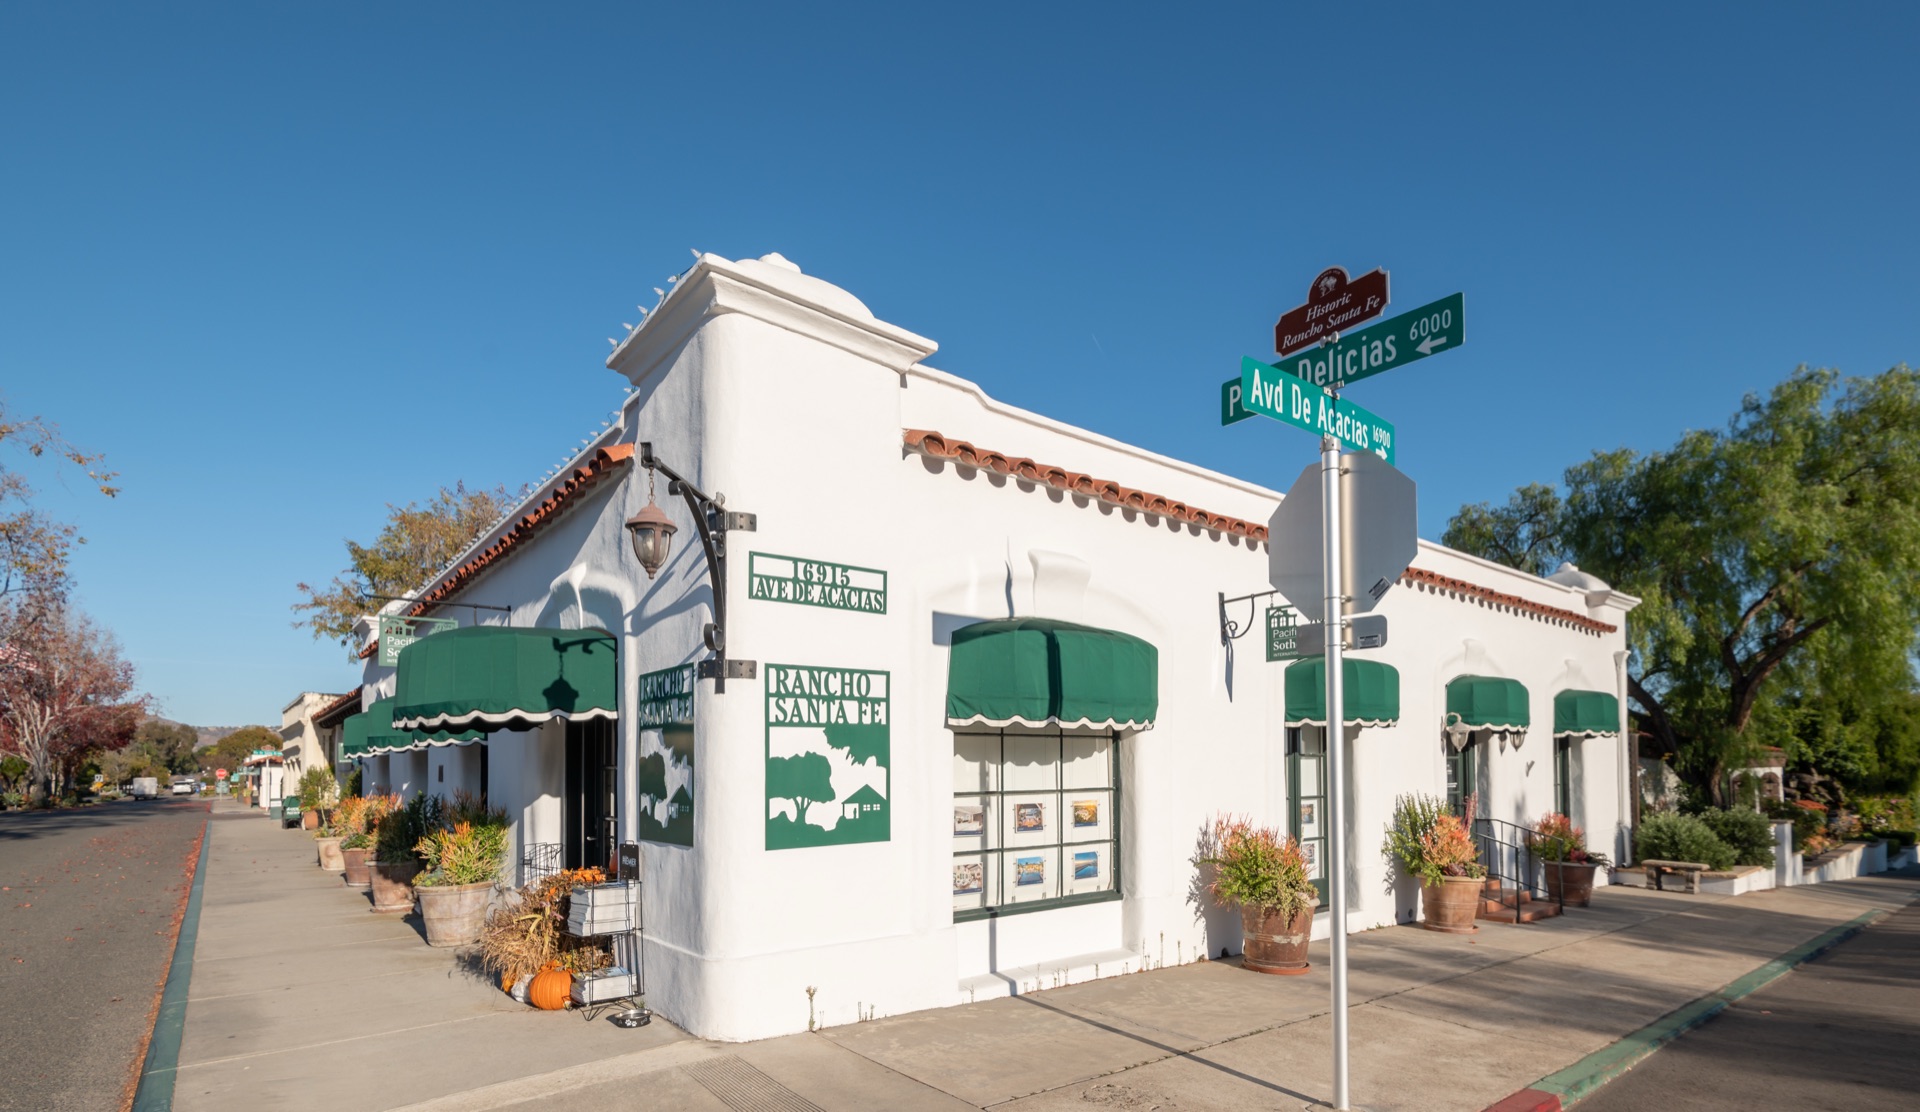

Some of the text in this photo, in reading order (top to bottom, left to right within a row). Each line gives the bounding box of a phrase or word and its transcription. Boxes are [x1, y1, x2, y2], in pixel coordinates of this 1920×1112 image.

[1282, 294, 1381, 350] Rancho Santa Fe
[1305, 292, 1352, 323] Historic
[1298, 334, 1397, 386] Delicias
[1409, 308, 1452, 341] 6000
[1251, 368, 1391, 449] Avd De Acacias 16900
[792, 560, 851, 587] 16915
[755, 576, 885, 612] AVE DE ACACIAS
[774, 669, 871, 698] RANCHO
[774, 698, 884, 725] SANTA FE
